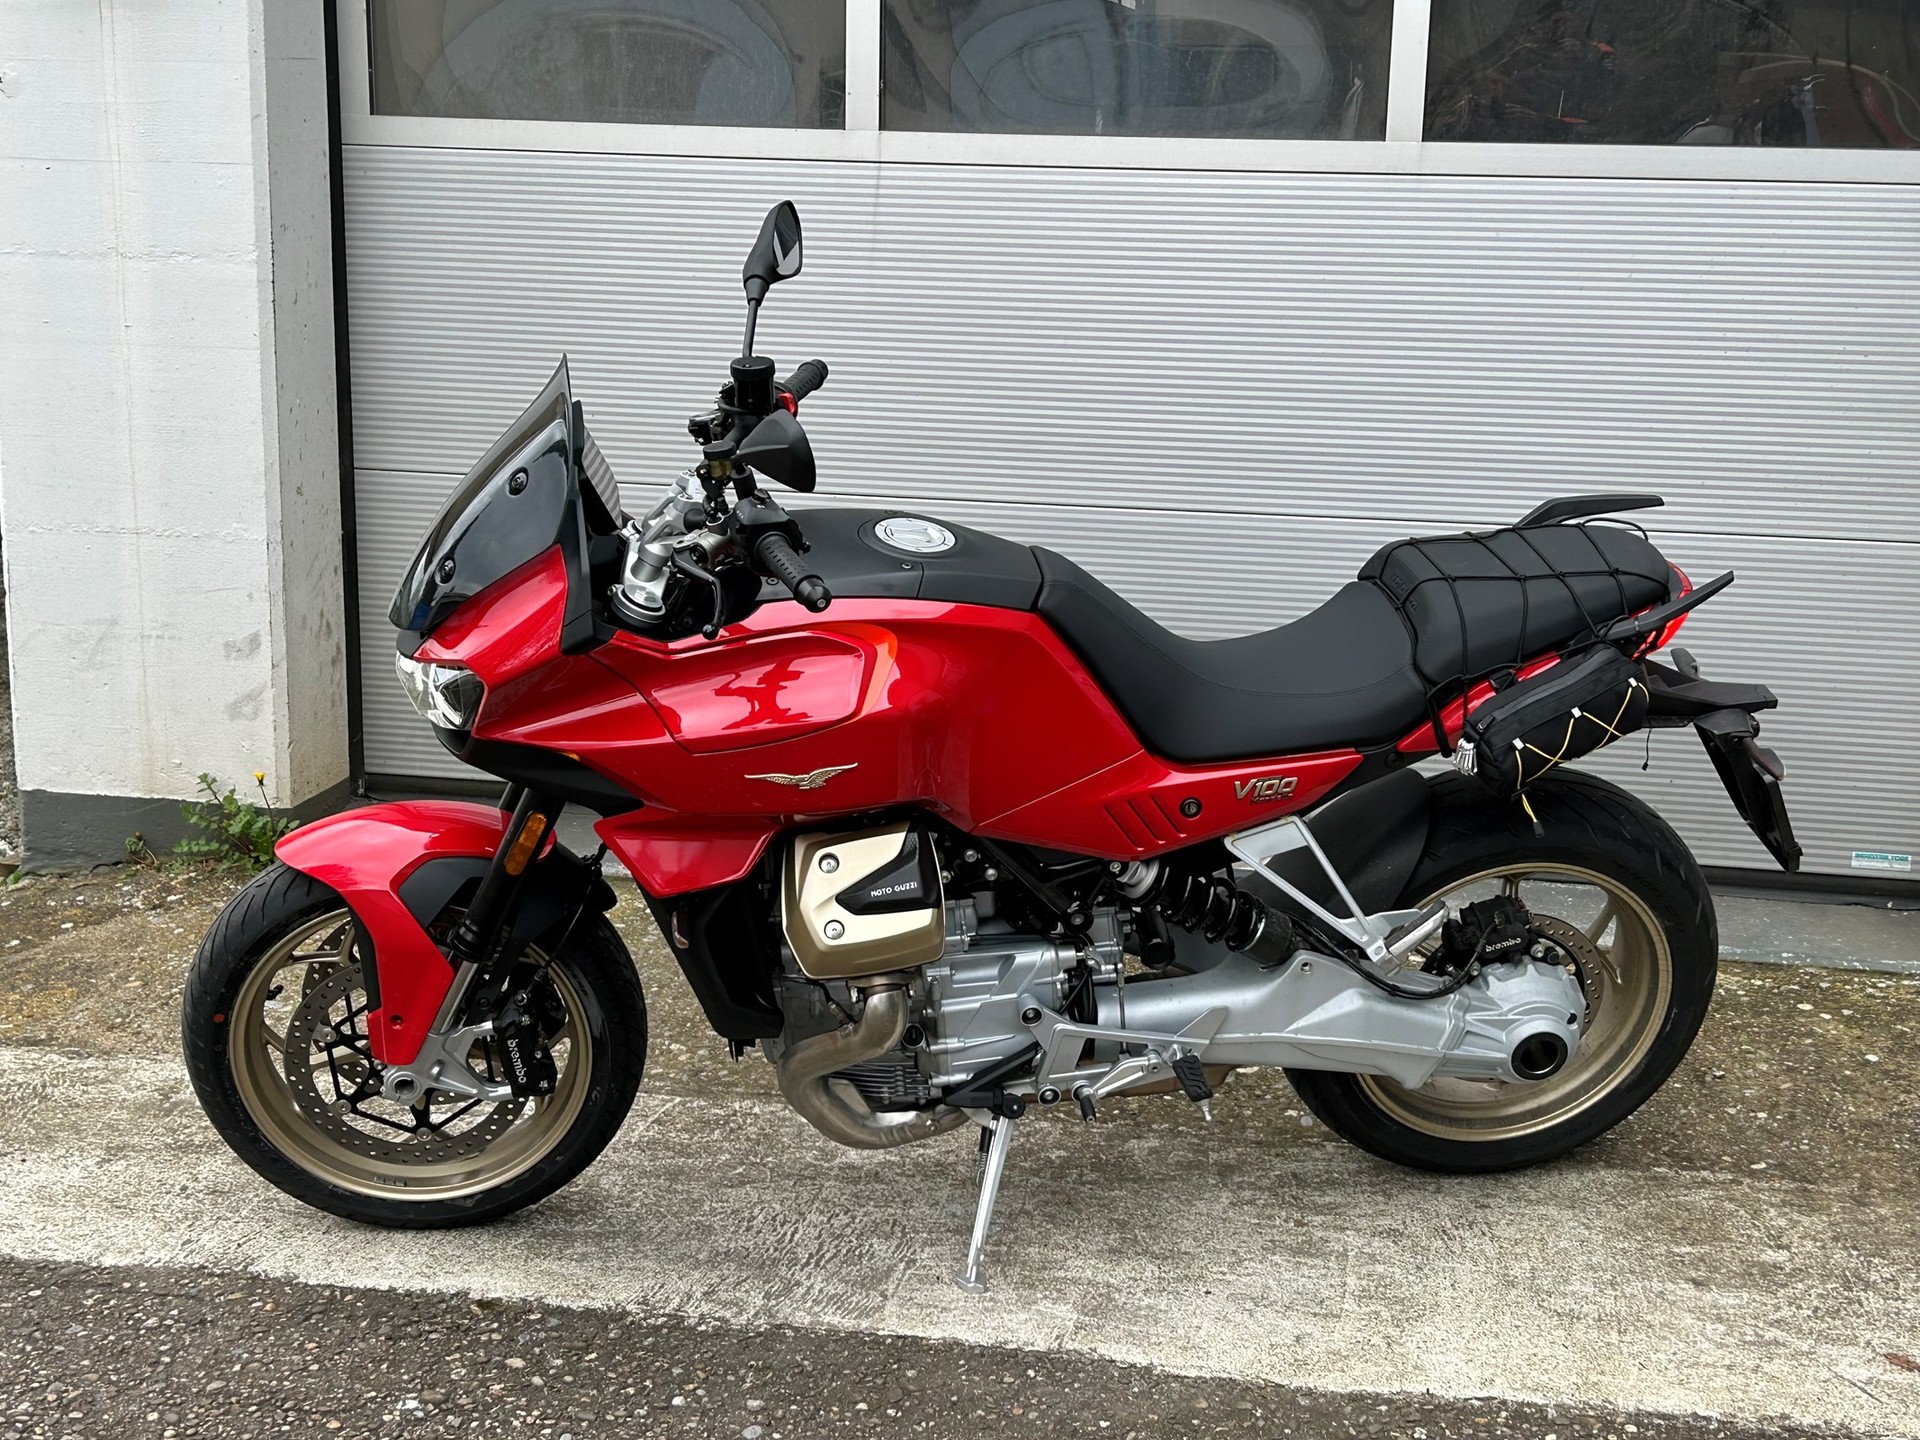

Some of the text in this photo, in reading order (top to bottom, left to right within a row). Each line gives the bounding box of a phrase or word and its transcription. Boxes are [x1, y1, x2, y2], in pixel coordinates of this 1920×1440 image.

[1234, 776, 1298, 799] V100
[870, 881, 918, 897] MOTO GUZZI
[1485, 937, 1522, 952] brembo
[507, 1038, 527, 1083] brembo
